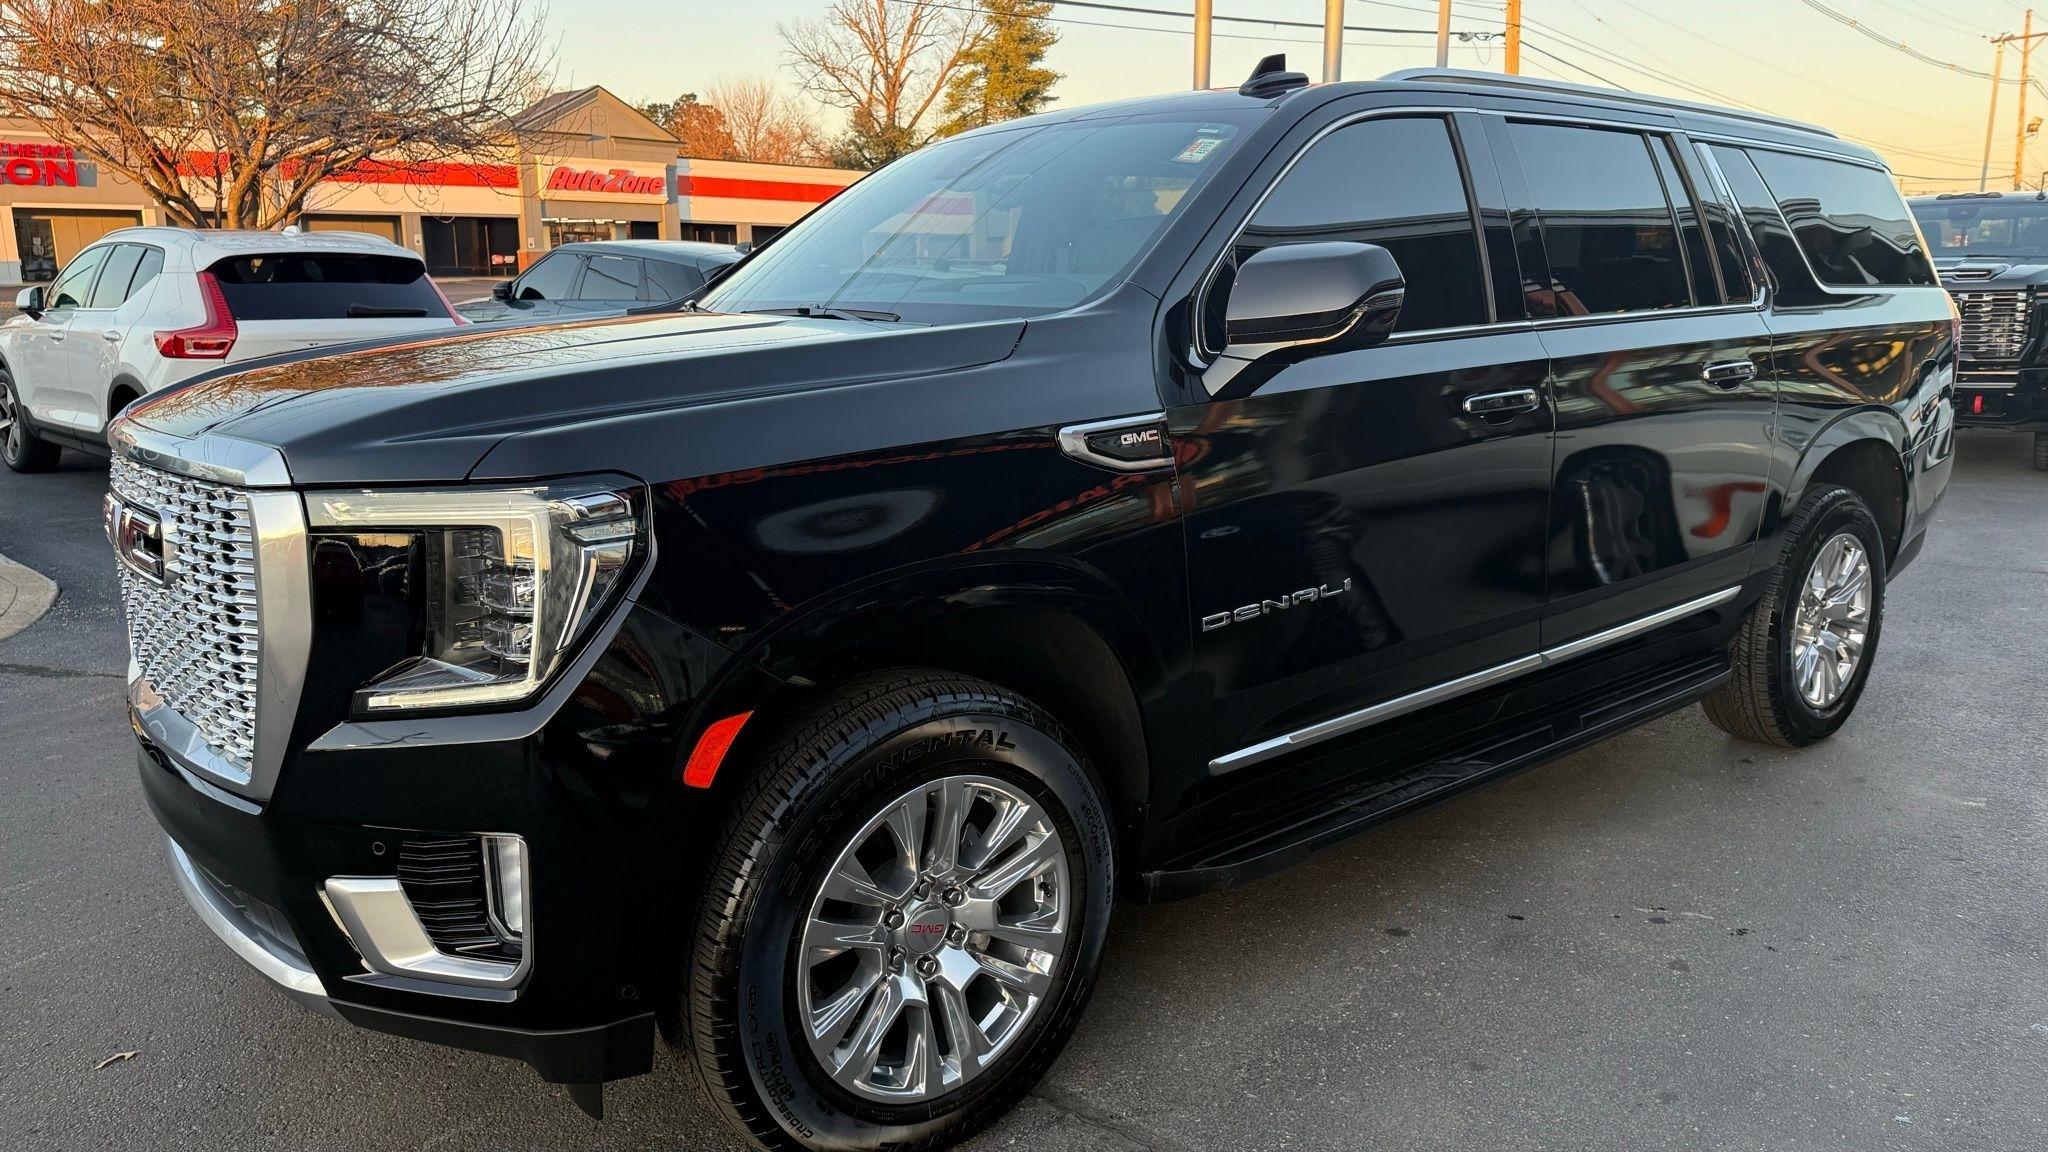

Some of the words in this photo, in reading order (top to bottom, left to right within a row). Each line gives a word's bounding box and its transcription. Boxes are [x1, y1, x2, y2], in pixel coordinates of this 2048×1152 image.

[547, 166, 665, 195] AutoZone
[1120, 429, 1159, 445] GMC
[1202, 577, 1352, 632] DENALI
[910, 924, 945, 934] GMC
